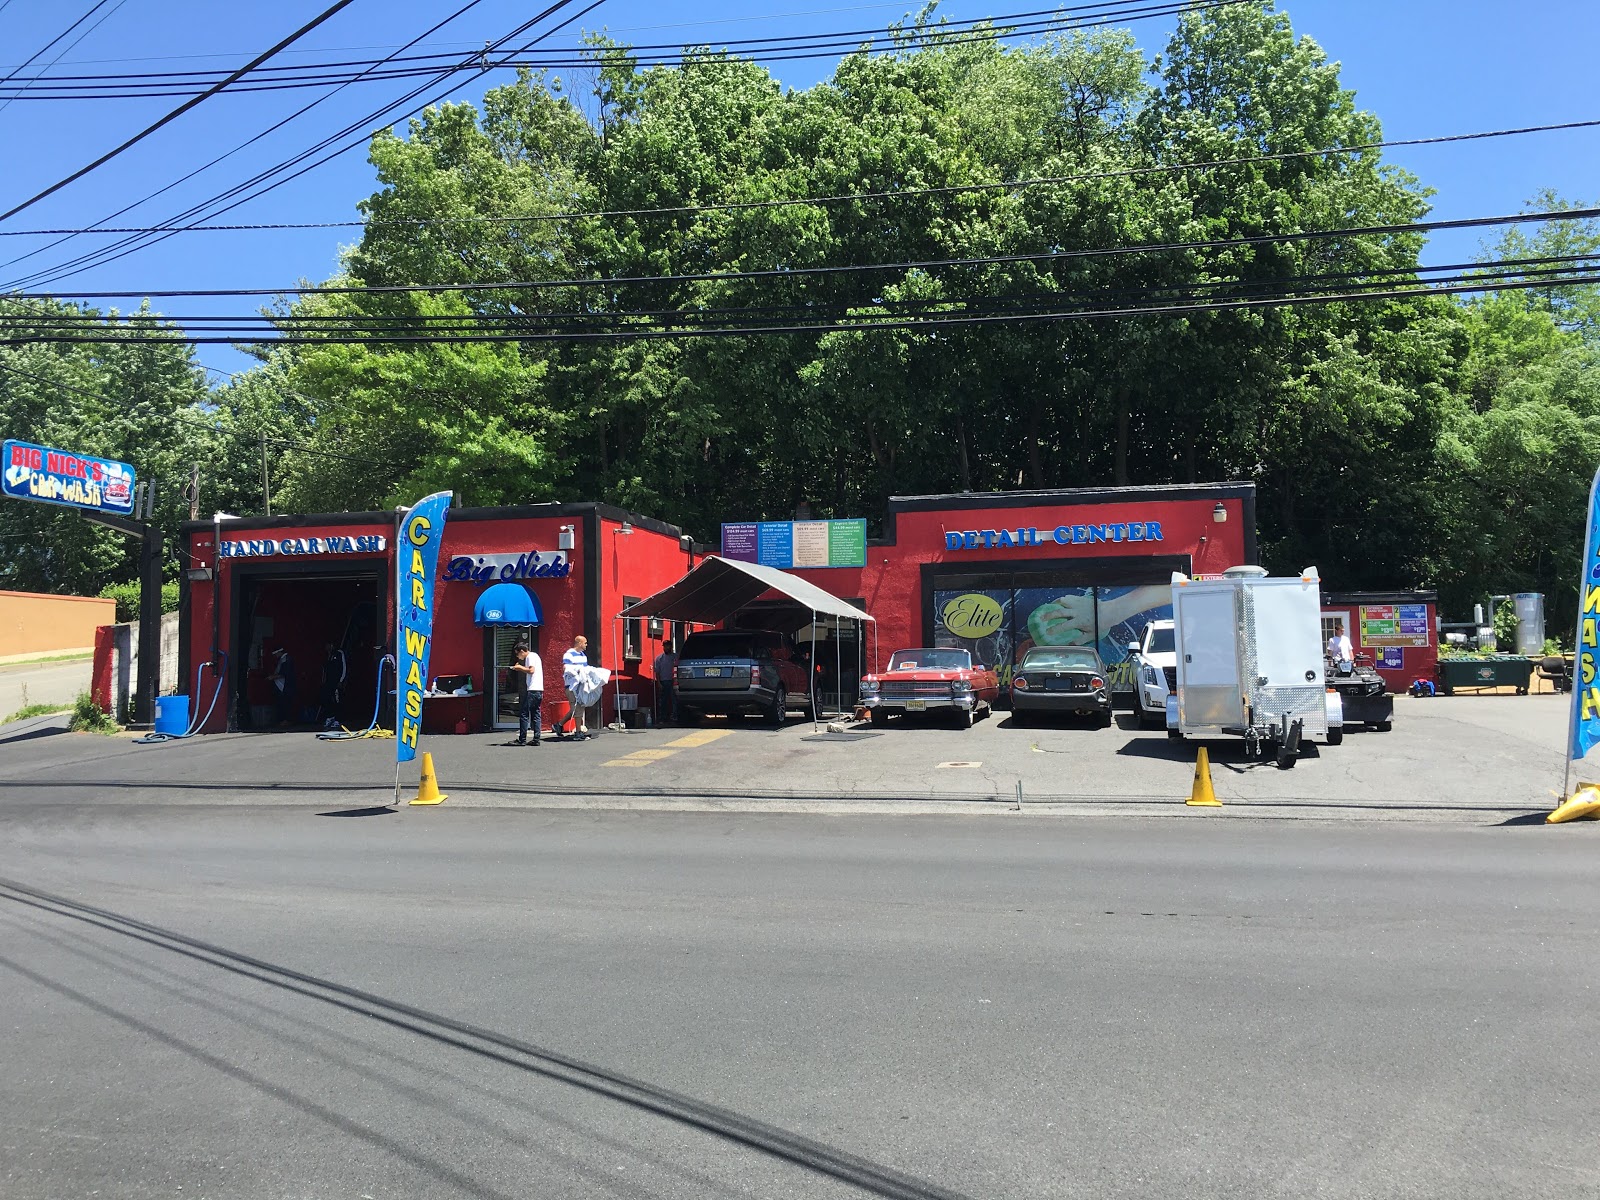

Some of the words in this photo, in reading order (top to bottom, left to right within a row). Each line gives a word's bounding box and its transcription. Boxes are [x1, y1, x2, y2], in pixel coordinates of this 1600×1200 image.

[12, 446, 41, 470] BIG
[48, 453, 103, 481] NICK'S
[30, 472, 57, 498] CAR
[63, 478, 101, 506] WASH
[219, 539, 275, 557] HAND
[280, 537, 321, 555] CAR
[325, 535, 382, 554] WASH
[945, 528, 1044, 550] DETAIL
[1053, 521, 1164, 545] CENTER
[408, 515, 431, 611] CAR
[442, 556, 496, 586] Big
[939, 598, 1000, 631] Elite
[402, 626, 427, 750] WASH
